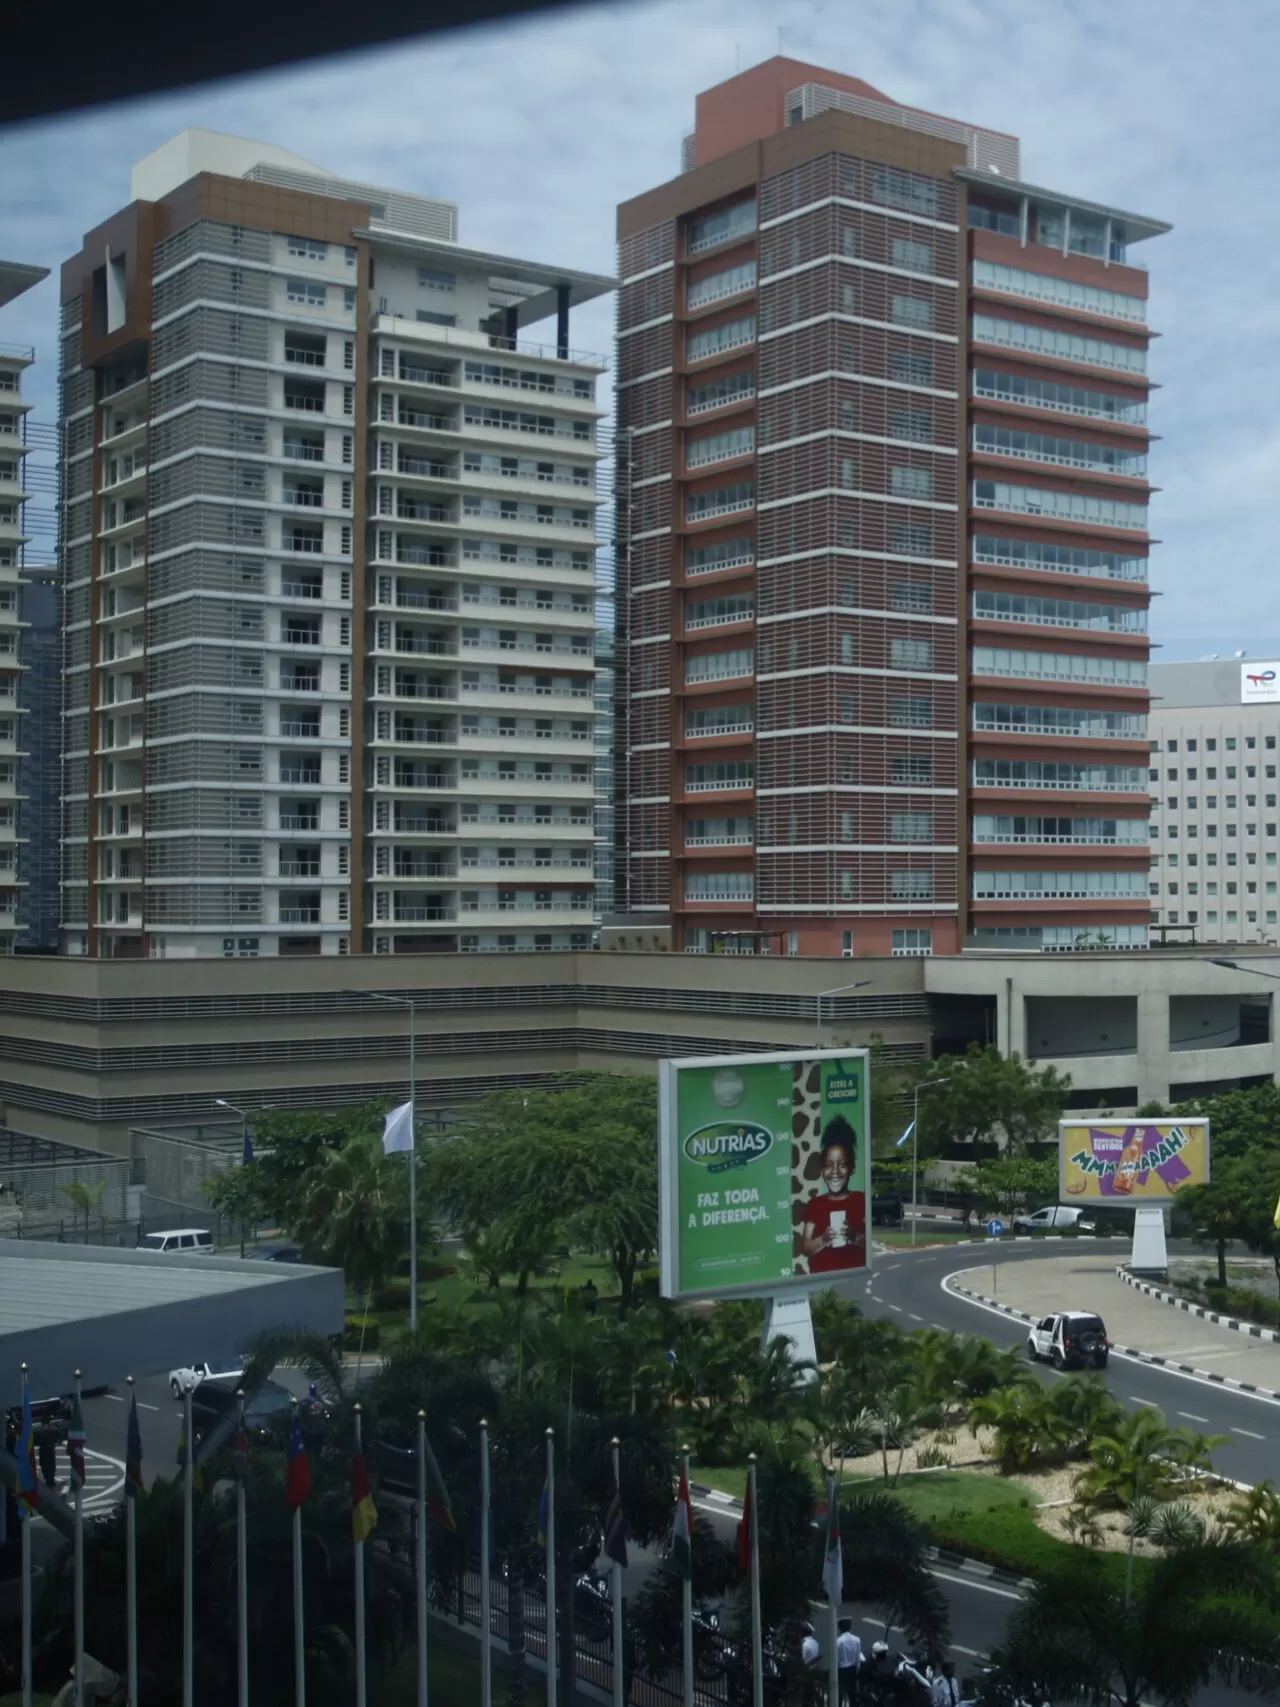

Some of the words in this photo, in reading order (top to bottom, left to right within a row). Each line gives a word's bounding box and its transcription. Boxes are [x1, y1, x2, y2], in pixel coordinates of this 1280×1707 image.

[693, 1130, 766, 1156] NUTRIAS
[697, 1191, 720, 1208] FAZ
[724, 1187, 759, 1205] TODA
[688, 1213, 697, 1228] A
[702, 1206, 770, 1226] DIFERENÇA.
